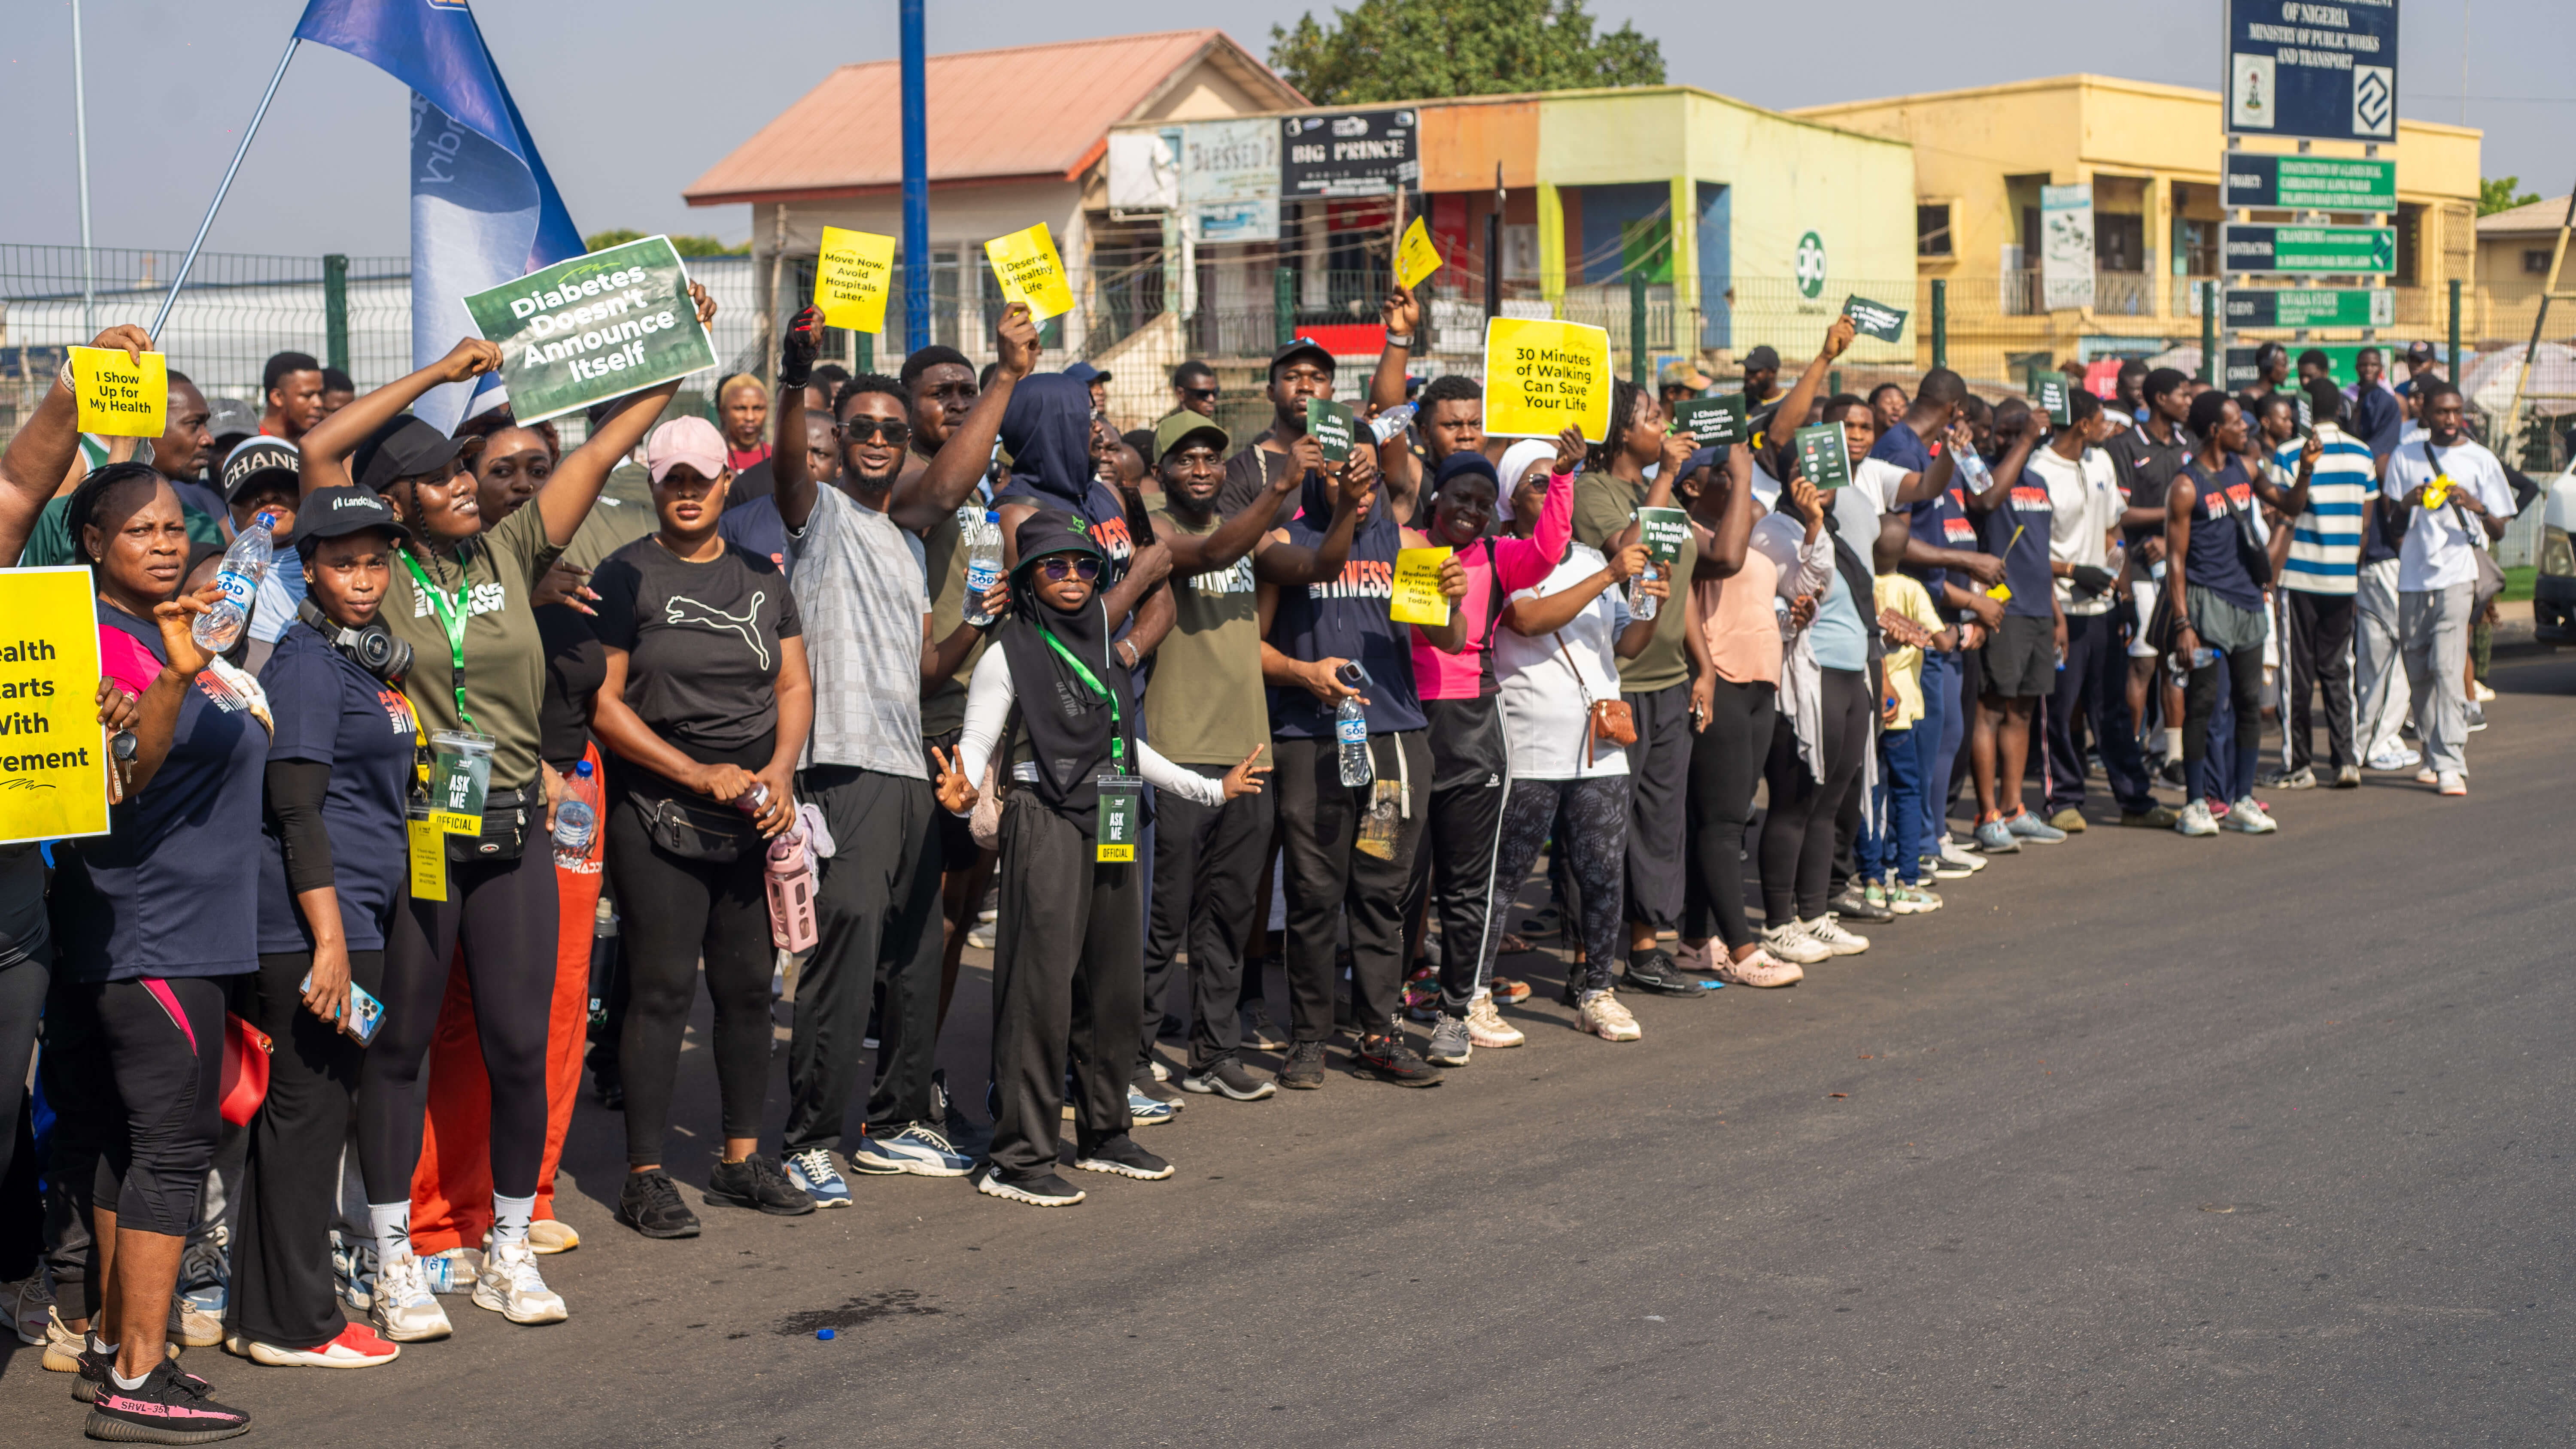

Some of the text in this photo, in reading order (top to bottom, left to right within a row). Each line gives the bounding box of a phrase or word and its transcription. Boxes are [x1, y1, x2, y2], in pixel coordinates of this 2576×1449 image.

[2281, 1, 2349, 28] OF NIGERIA
[2248, 22, 2380, 52] MINISTRY OF PUBLIC WORKS
[2277, 47, 2354, 70] AND TRANSPORT
[1292, 139, 1405, 164] BIG PRINCE
[2229, 174, 2262, 189] PROJECT:
[825, 253, 884, 270] Move Now.
[1000, 253, 1048, 273] I Deserve
[1798, 238, 1825, 292] glo
[837, 267, 868, 279] Avoid
[1013, 265, 1052, 284] Healthy
[826, 277, 876, 291] Hospitals
[1023, 282, 1042, 294] Life
[510, 265, 646, 320] Diabetes
[834, 290, 864, 302] Later.
[529, 288, 648, 338] Doesn't
[524, 310, 675, 369] Announce
[568, 340, 645, 383] Itself
[1517, 348, 1591, 366] 30 Minutes
[96, 371, 139, 384] I Show
[1517, 364, 1591, 384] of Walking
[2227, 365, 2260, 381] CONSULT
[100, 385, 139, 399] Up for
[1524, 380, 1587, 396] Can Save
[90, 398, 151, 414] My Health
[1525, 395, 1587, 411] Your Life
[1689, 415, 1733, 427] Prevention
[1693, 409, 1728, 419] I Choose
[1702, 424, 1722, 433] Over
[224, 452, 299, 489] CHANE
[1646, 520, 1660, 530] I'm
[1649, 532, 1655, 540] a
[1408, 597, 1432, 606] Today
[0, 639, 56, 663] alth
[0, 678, 55, 699] arts
[385, 705, 403, 735] WALK
[1346, 728, 1364, 736] SOD
[0, 747, 89, 772] ement
[449, 774, 471, 793] ASK
[449, 792, 466, 809] ME
[436, 815, 472, 831] OFFICIAL
[1109, 812, 1124, 826] ASK
[1110, 827, 1122, 840] ME
[1103, 848, 1128, 858] OFFICIAL
